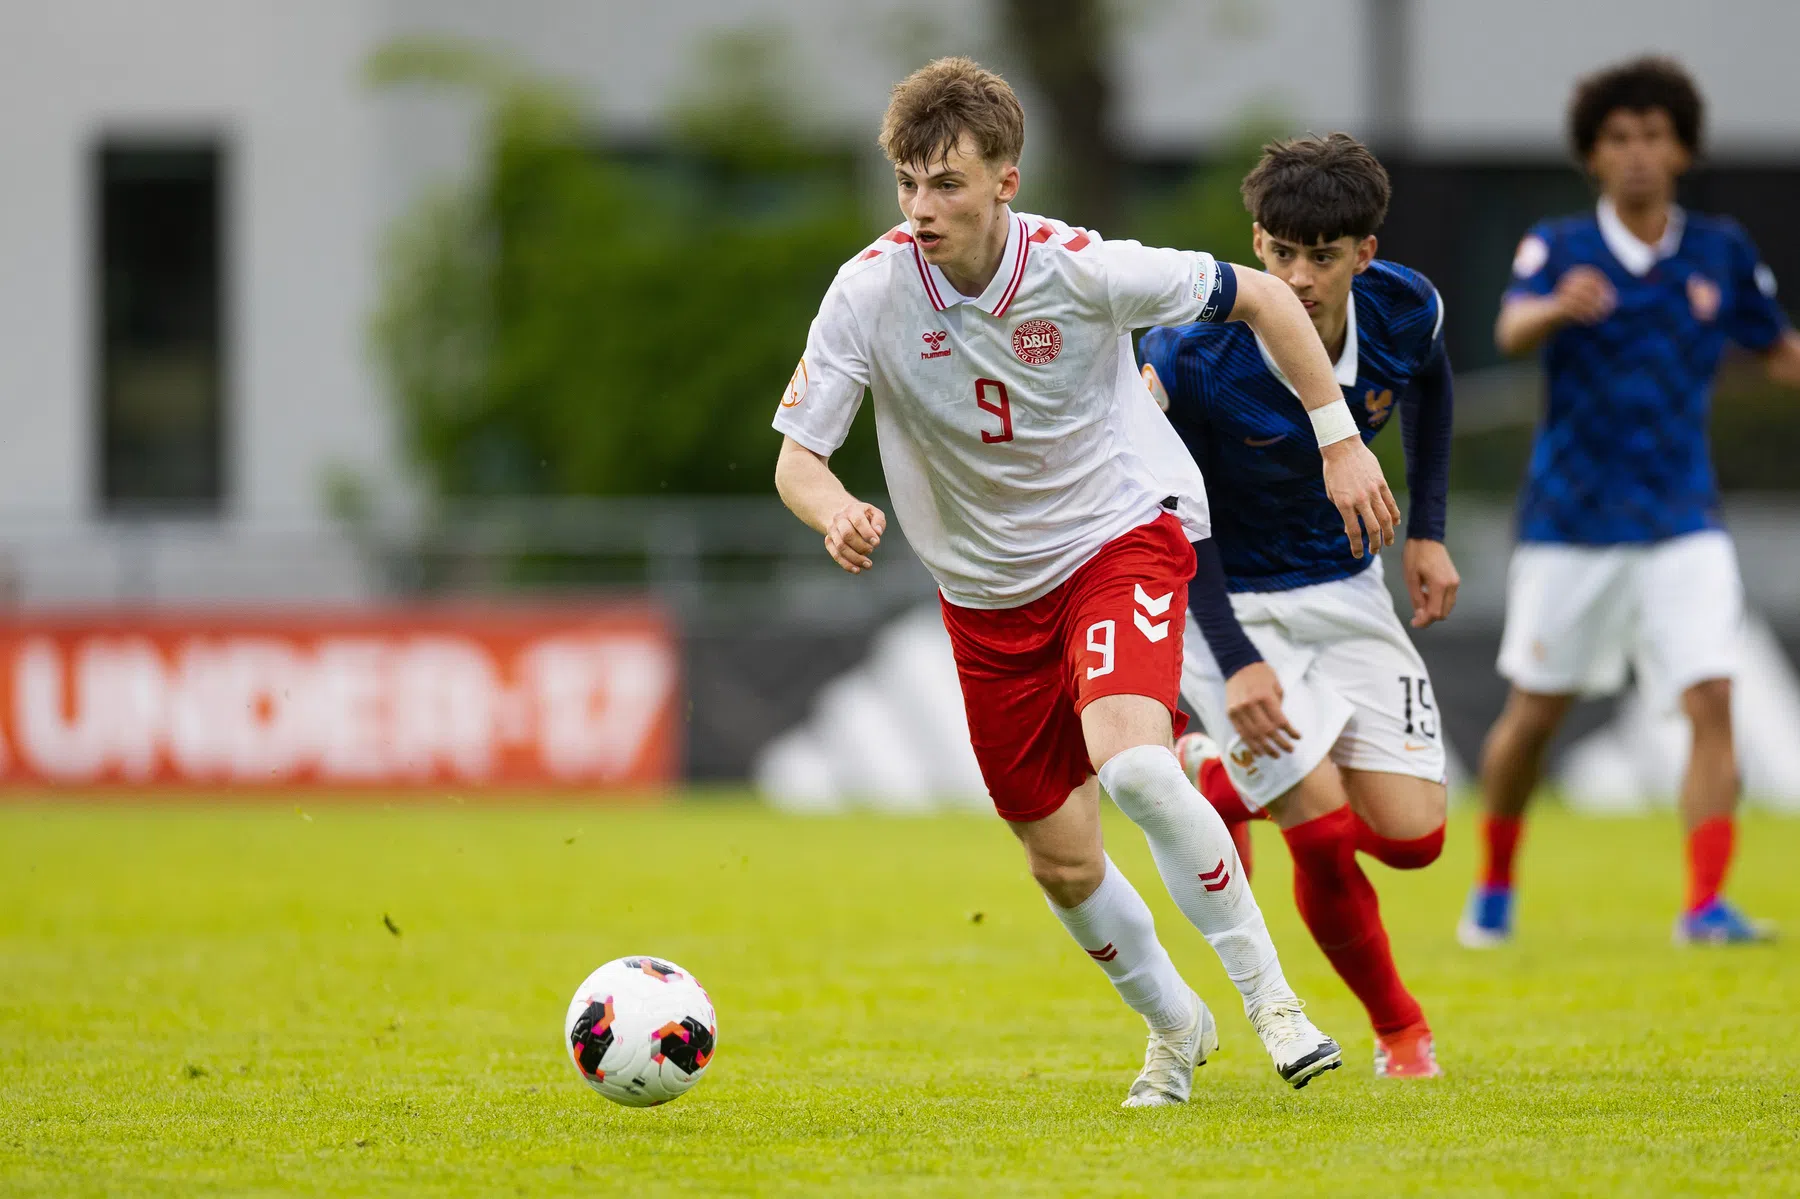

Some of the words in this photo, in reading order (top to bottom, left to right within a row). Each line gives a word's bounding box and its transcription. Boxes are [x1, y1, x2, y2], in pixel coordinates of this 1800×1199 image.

[1021, 333, 1053, 349] DBU
[1052, 330, 1061, 355] UNION
[921, 348, 951, 360] hummel
[974, 377, 1014, 445] 9
[1086, 619, 1116, 680] 9
